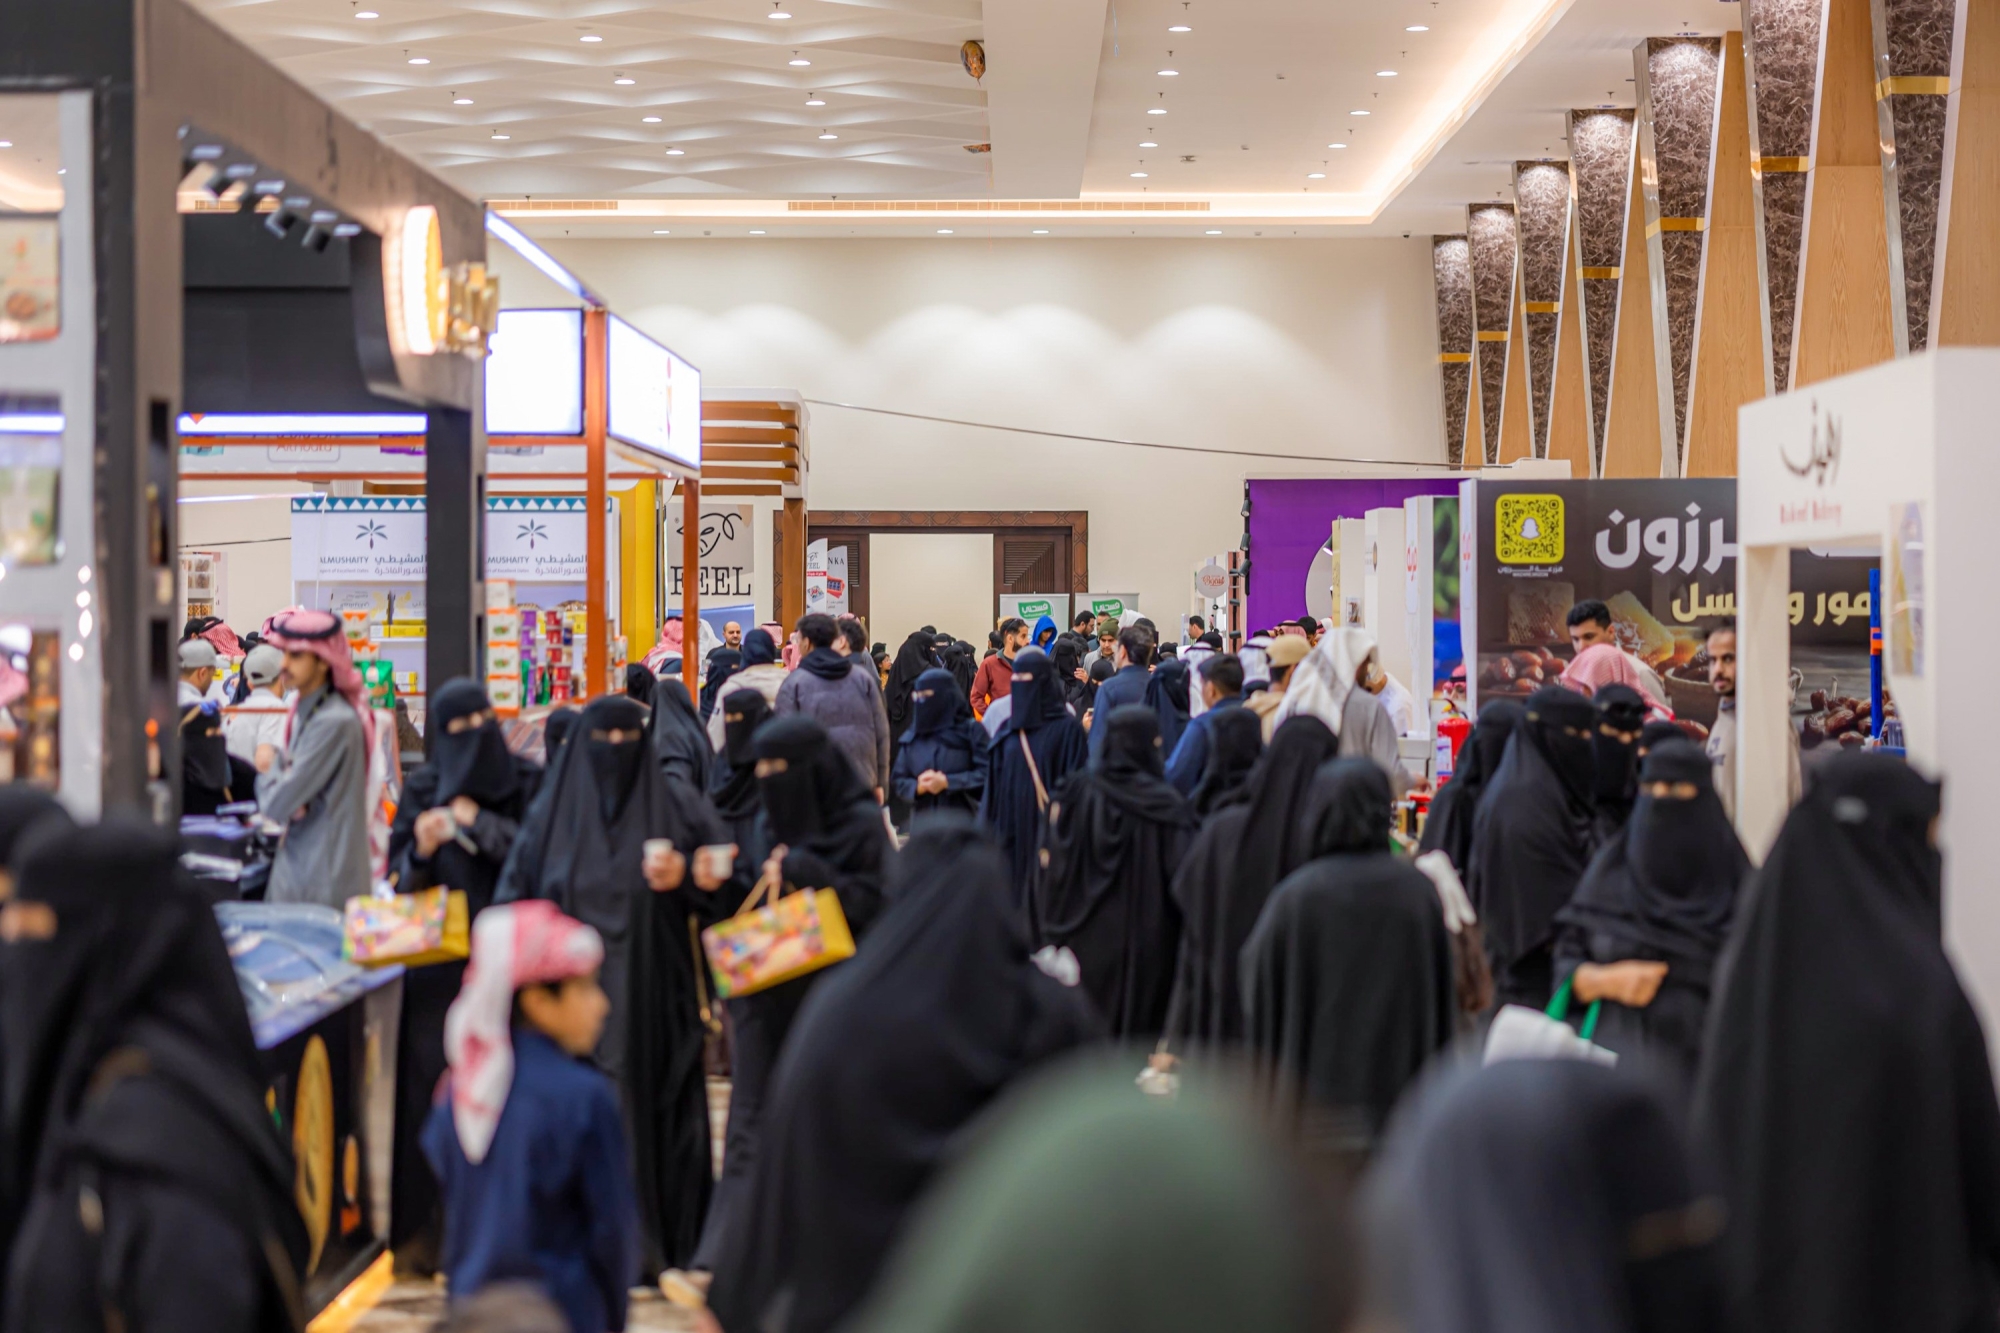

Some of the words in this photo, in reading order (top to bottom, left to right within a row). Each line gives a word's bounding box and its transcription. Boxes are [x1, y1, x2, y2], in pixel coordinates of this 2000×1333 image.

[1595, 501, 1738, 575] رزون
[487, 556, 530, 564] MUSHAITY
[1672, 582, 1738, 623] سل
[1813, 592, 1871, 626] مور
